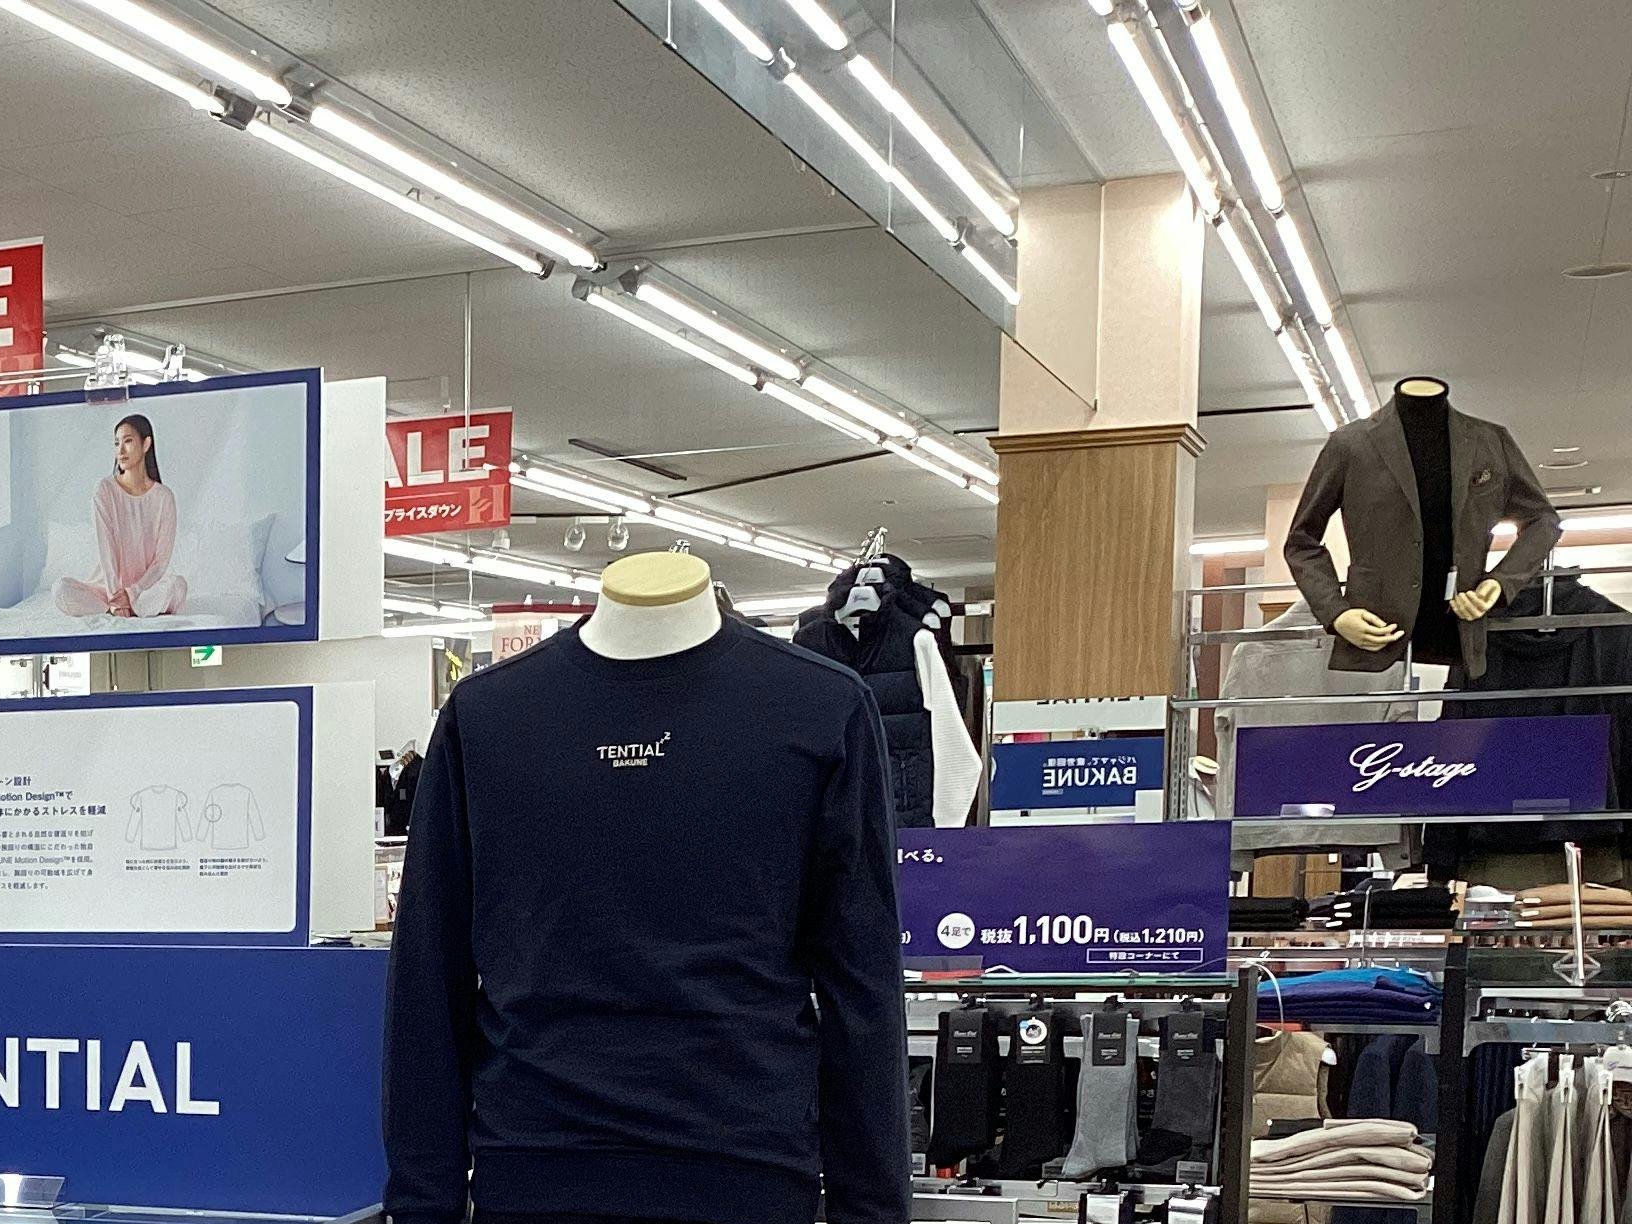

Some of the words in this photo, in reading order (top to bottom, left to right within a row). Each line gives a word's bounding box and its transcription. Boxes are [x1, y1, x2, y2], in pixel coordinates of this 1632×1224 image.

[596, 741, 666, 759] TENTIAL
[1349, 743, 1477, 792] G-stage
[897, 848, 944, 864] べる。
